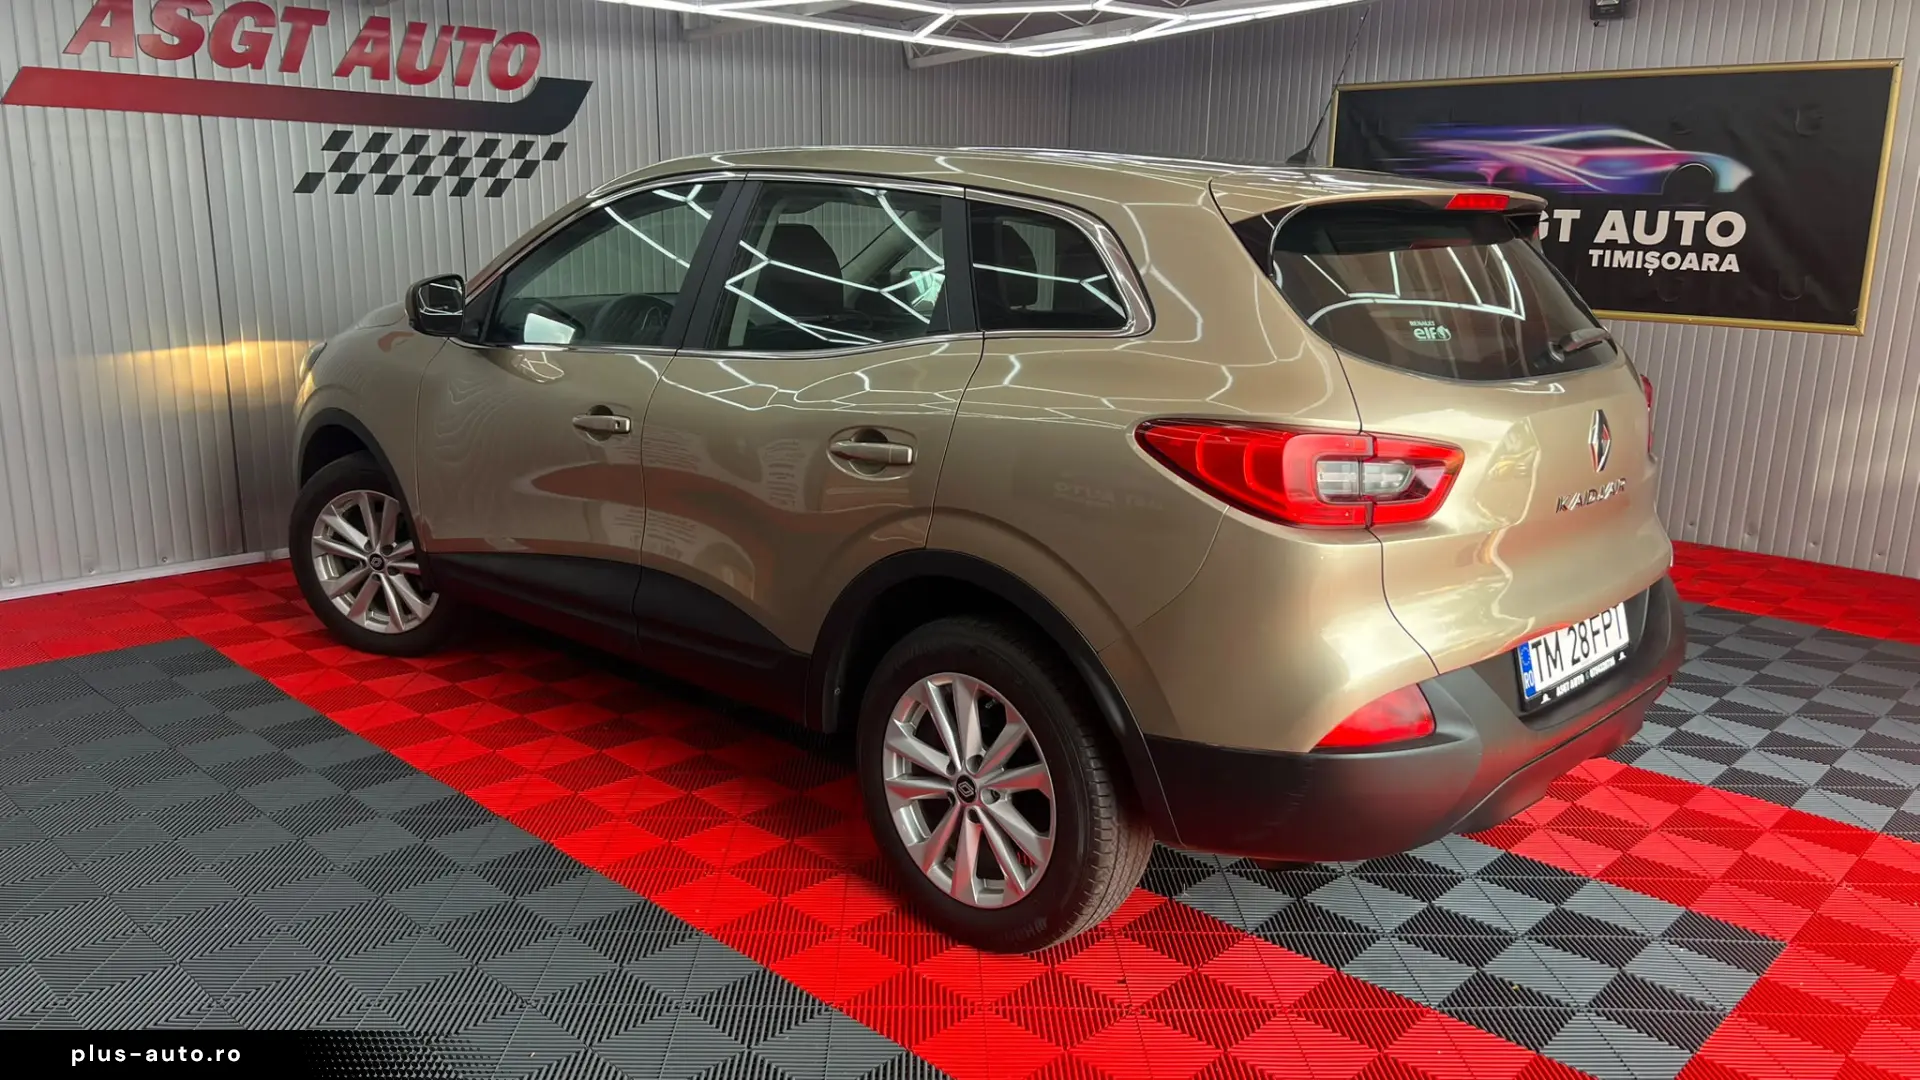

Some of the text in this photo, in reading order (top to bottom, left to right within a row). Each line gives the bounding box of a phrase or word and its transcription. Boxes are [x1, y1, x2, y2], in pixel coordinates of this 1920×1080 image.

[62, 0, 541, 91] ASGT AUTO
[1593, 210, 1747, 247] AUTO
[1589, 249, 1740, 276] TIMIȘOARA
[1531, 631, 1564, 682] TM
